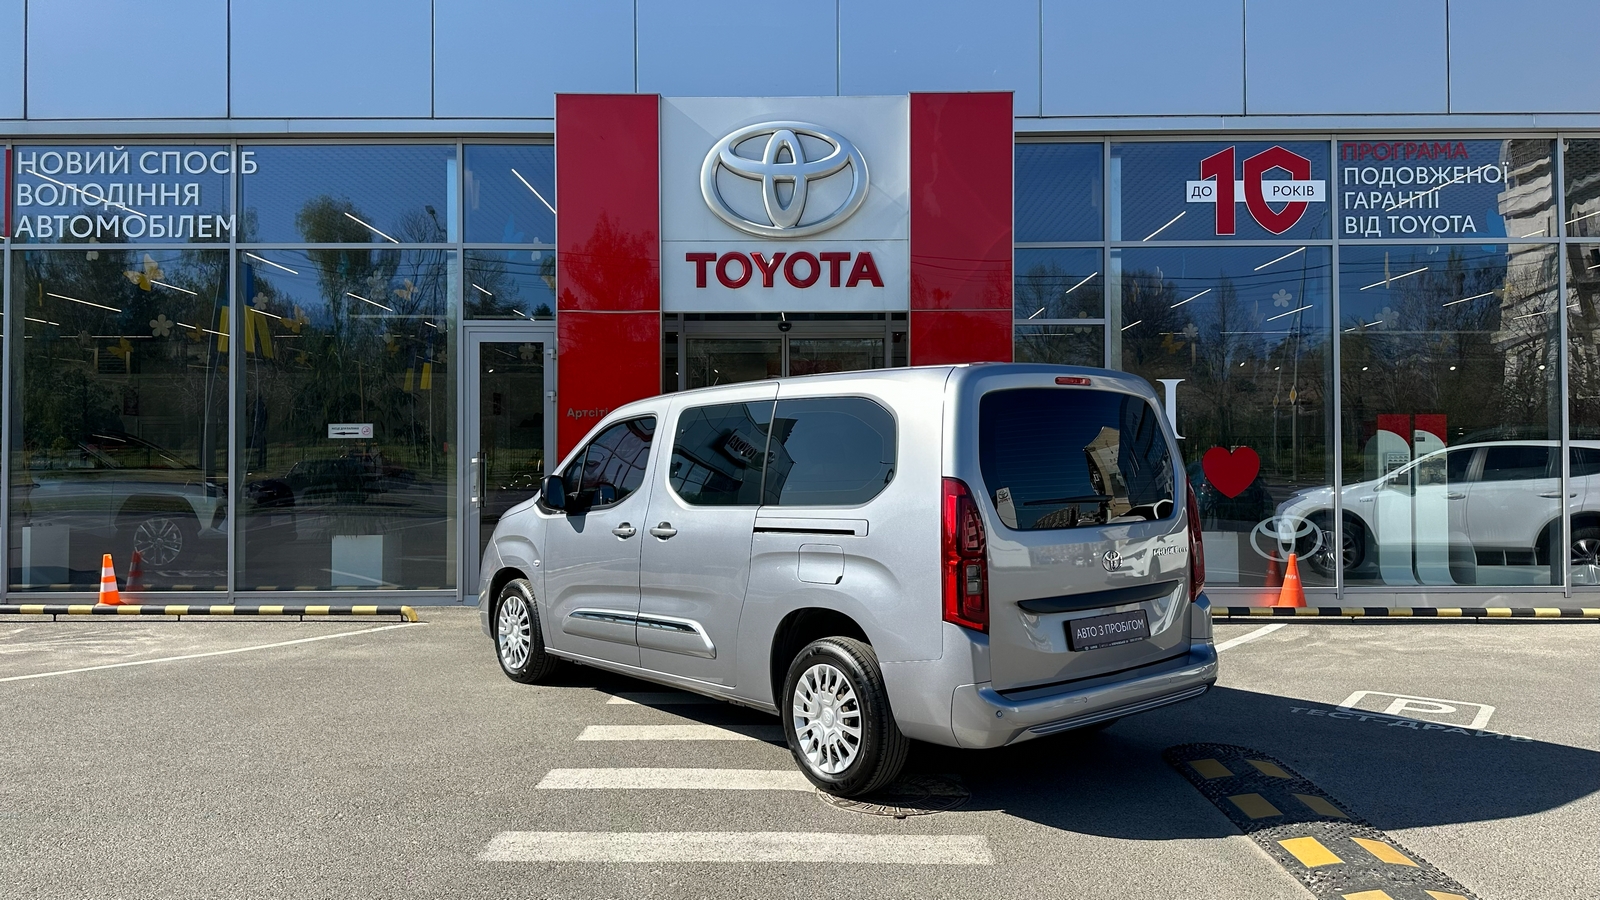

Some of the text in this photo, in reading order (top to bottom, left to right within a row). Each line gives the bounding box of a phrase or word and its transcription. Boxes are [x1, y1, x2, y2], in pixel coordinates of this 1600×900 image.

[17, 145, 258, 175] НОВИЙ СПОСІБ
[1342, 141, 1469, 161] ПРОГРАМА
[1344, 161, 1509, 187] ПОДОВЖЕНОЇ
[16, 182, 200, 211] ВОЛОДІННЯ
[1191, 145, 1315, 236] ДО 10 РОКІВ
[1344, 187, 1440, 210] ГАРАНТІЇ
[14, 214, 237, 239] АВТОМОБІЛЕМ
[1344, 214, 1477, 238] ВІД TOYOTA
[685, 251, 885, 289] TOYOTA
[1076, 625, 1098, 640] АВТО
[1104, 618, 1145, 635] ПРОБІГОМ
[1384, 697, 1457, 715] P
